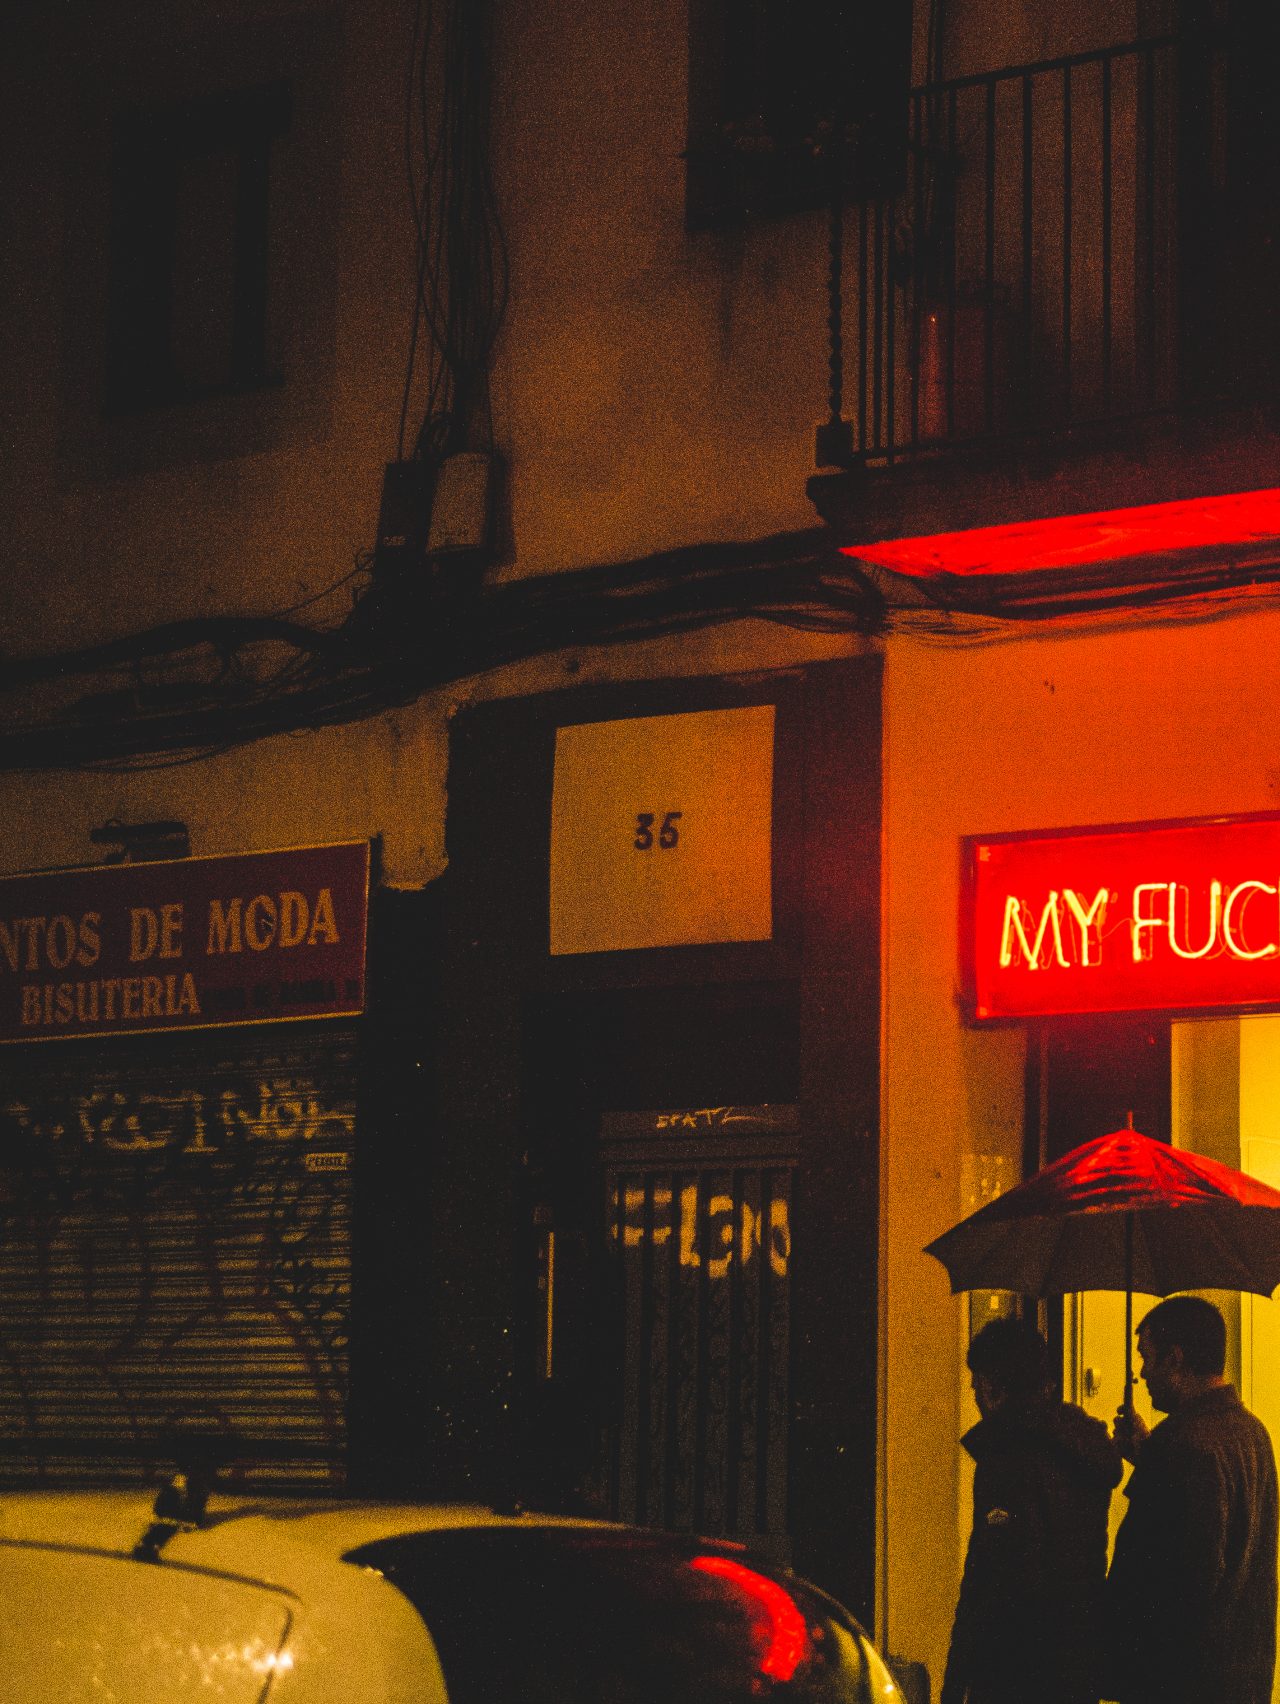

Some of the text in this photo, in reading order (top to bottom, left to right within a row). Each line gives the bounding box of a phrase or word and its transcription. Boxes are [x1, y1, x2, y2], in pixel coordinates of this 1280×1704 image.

[634, 811, 683, 850] 35
[129, 903, 185, 962] DE
[207, 888, 341, 955] MODA
[1000, 888, 1109, 970] MY
[21, 972, 201, 1025] BISUTERIA
